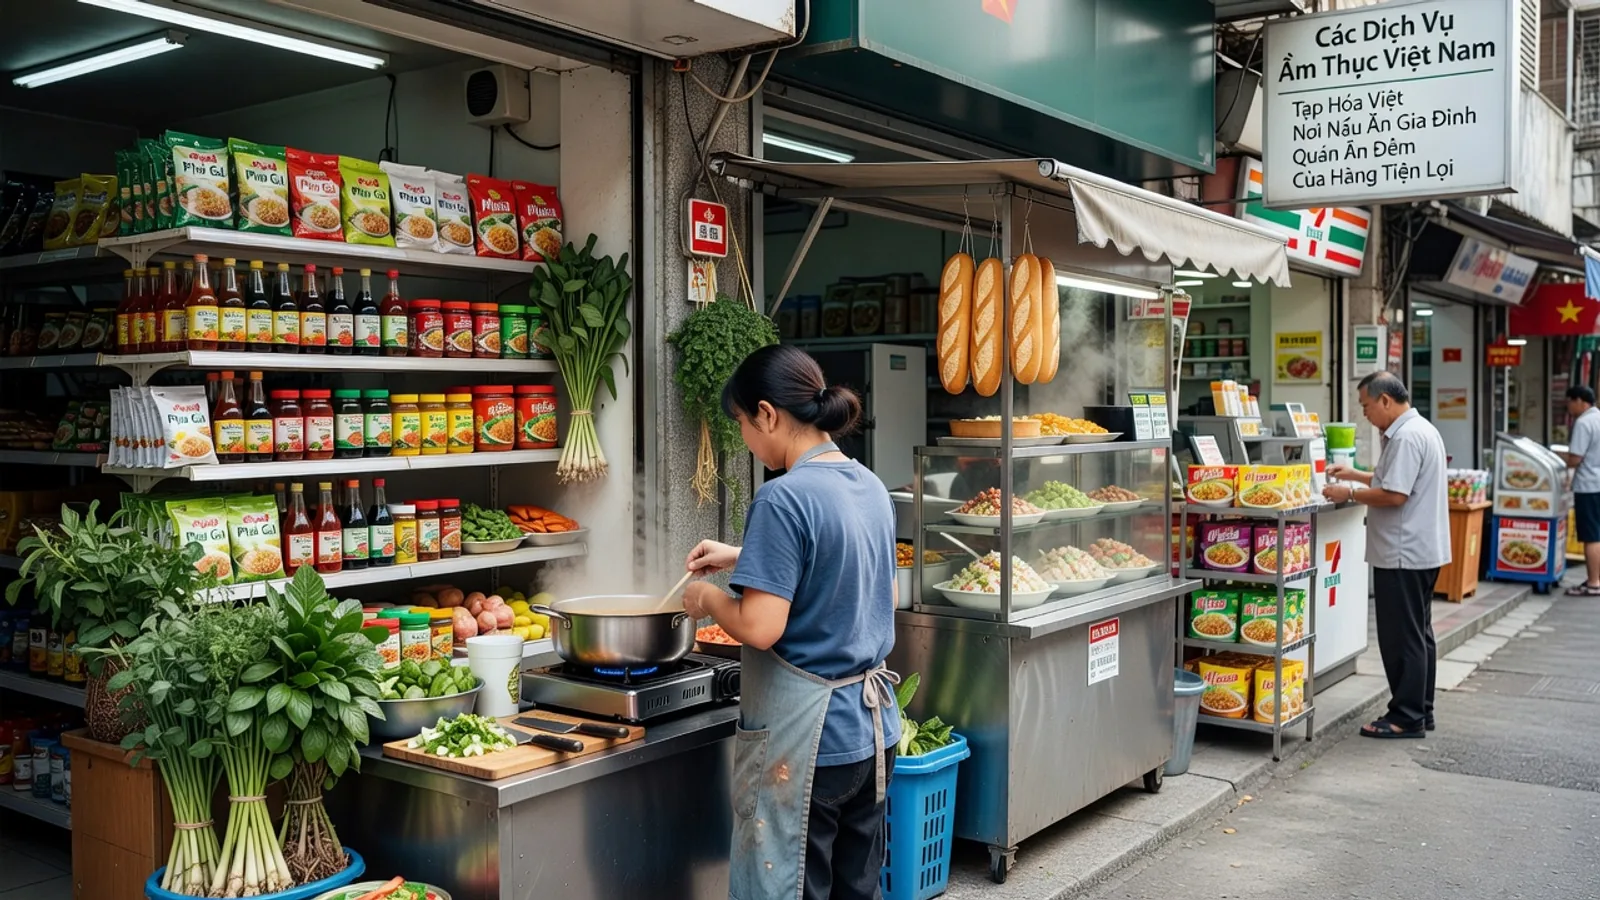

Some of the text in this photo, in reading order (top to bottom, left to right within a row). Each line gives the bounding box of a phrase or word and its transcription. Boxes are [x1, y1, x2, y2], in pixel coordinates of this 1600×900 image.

[1315, 10, 1454, 47] Các Dịch Vụ
[1321, 53, 1379, 79] Thục
[1383, 45, 1432, 72] Việt
[1438, 40, 1495, 64] Nam
[1292, 89, 1404, 121] Tạp Hóa Việt
[1397, 112, 1427, 131] Gia
[1292, 144, 1339, 167] Quán
[1331, 166, 1378, 187] Hàng
[1381, 162, 1420, 184] Tiện
